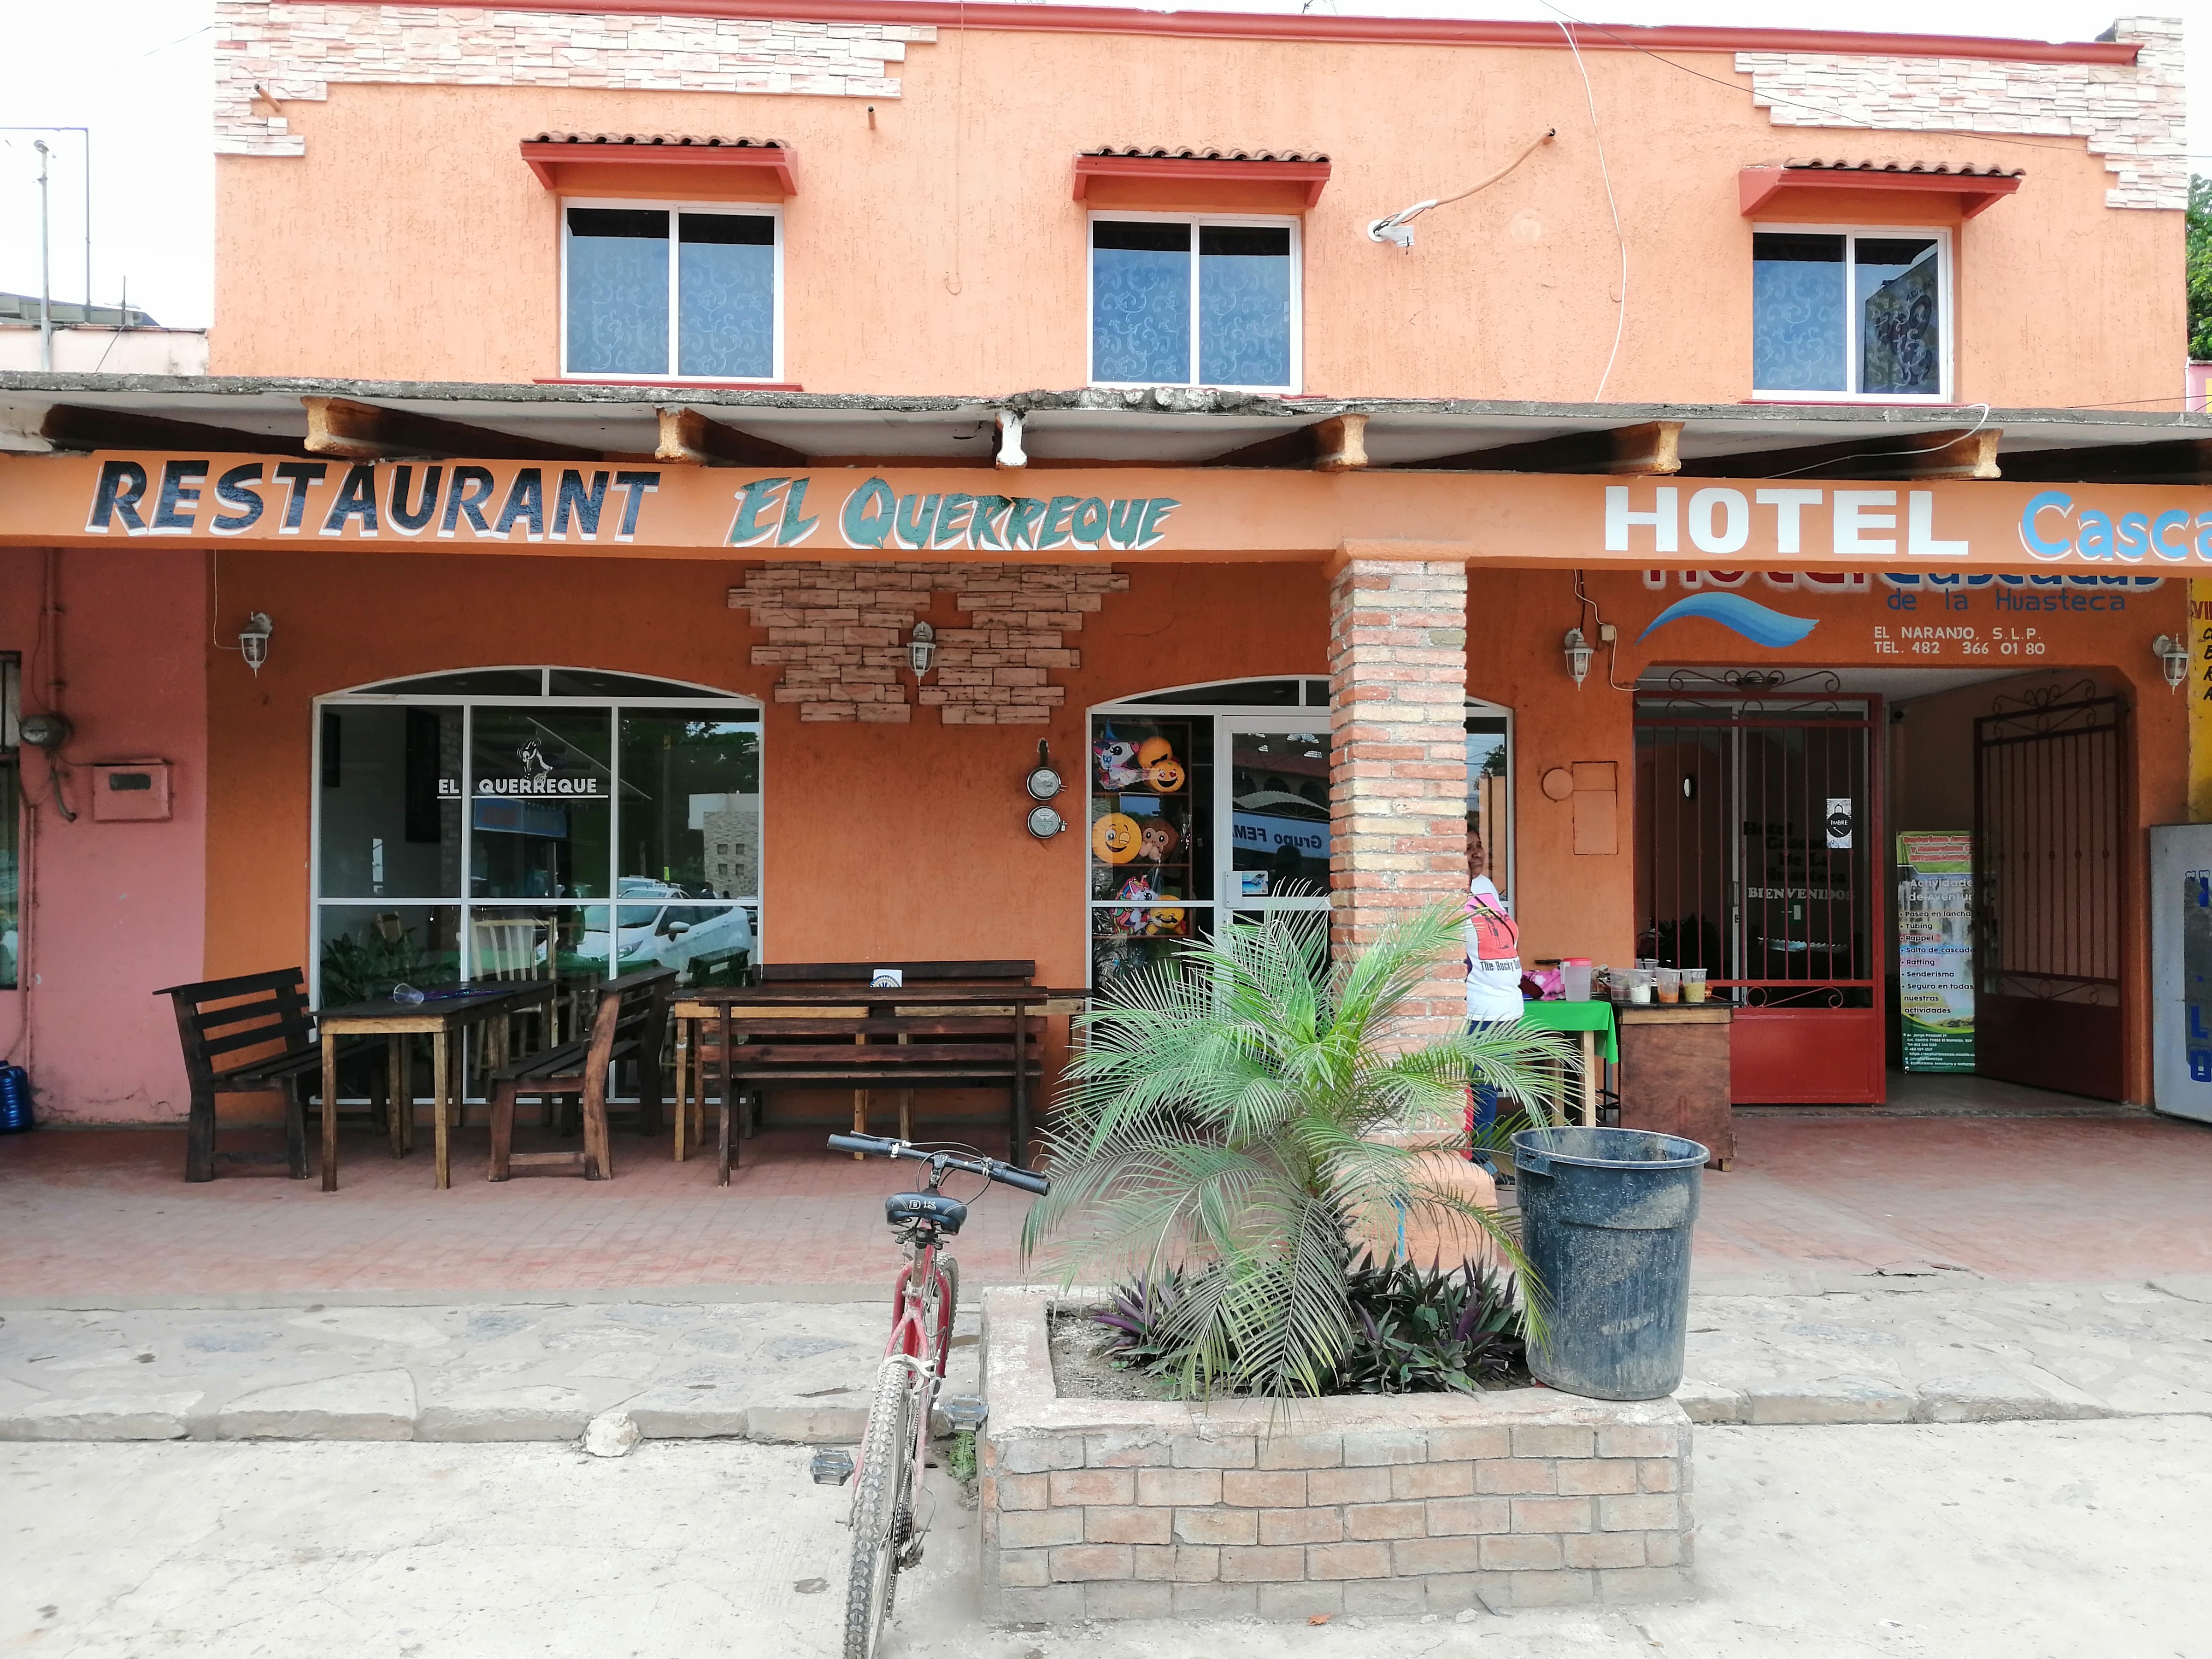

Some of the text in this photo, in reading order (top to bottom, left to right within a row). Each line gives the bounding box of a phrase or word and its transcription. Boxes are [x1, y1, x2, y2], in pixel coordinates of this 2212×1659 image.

[85, 460, 661, 542] RESTAURANT
[722, 476, 820, 547] EL
[838, 475, 1182, 551] QUERREQUE
[1605, 485, 1970, 556] HOTEL
[1888, 588, 2125, 612] de la Huasteca
[1874, 626, 2041, 641] EL NARANJO, S.L.P.
[1874, 641, 2045, 655] TEL. 482 366 01 80
[439, 778, 597, 794] EL QUERREQUE
[1910, 877, 1973, 887] Actividade
[1909, 892, 1924, 901] de
[1480, 961, 1494, 971] The
[1495, 960, 1514, 972] Rocky
